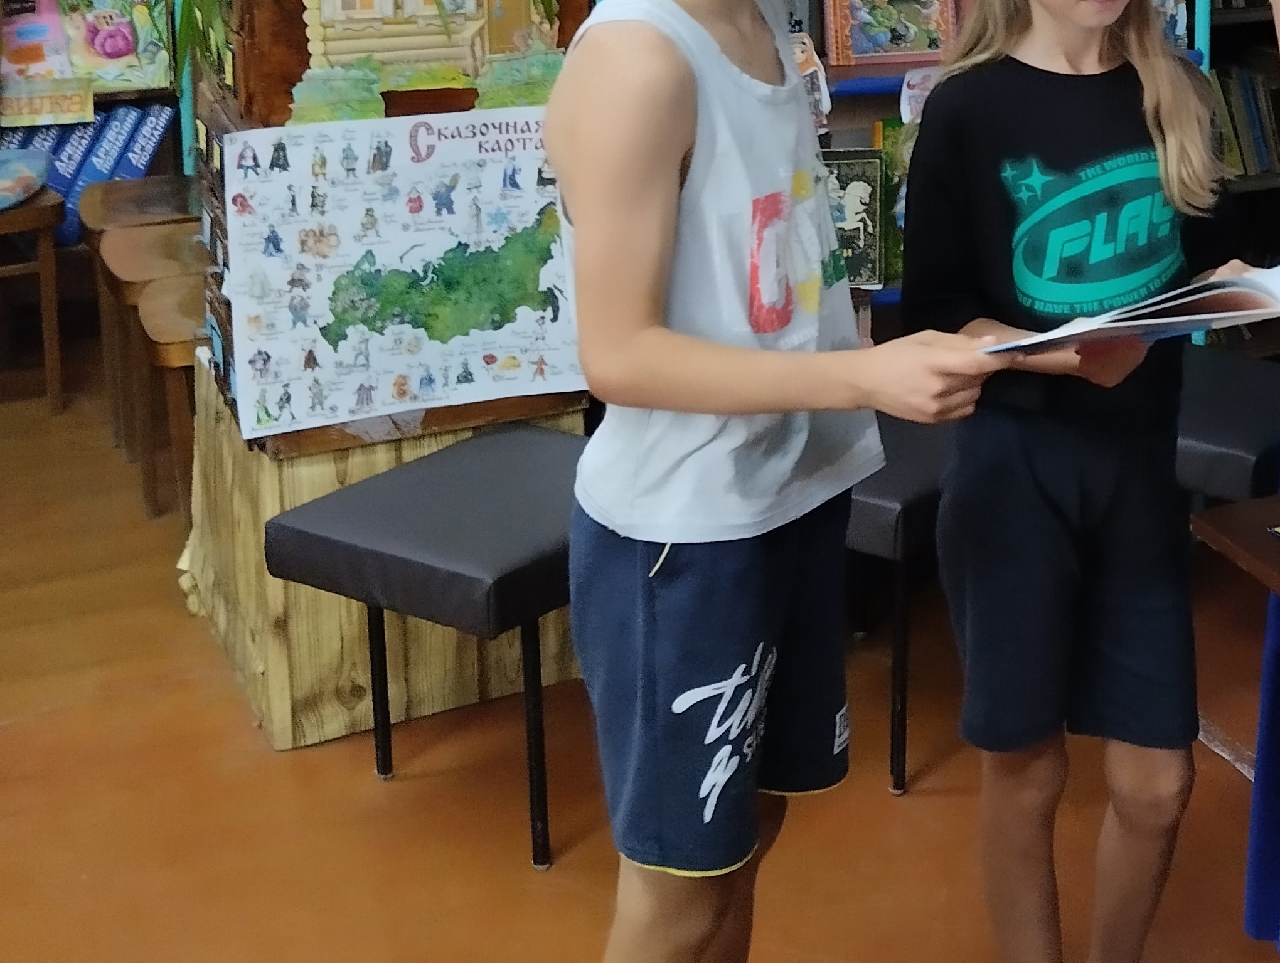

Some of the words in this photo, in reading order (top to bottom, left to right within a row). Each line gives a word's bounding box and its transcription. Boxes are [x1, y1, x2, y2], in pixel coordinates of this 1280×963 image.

[409, 120, 547, 164] Сказочная
[478, 135, 548, 158] карта
[1041, 191, 1175, 281] PLAY
